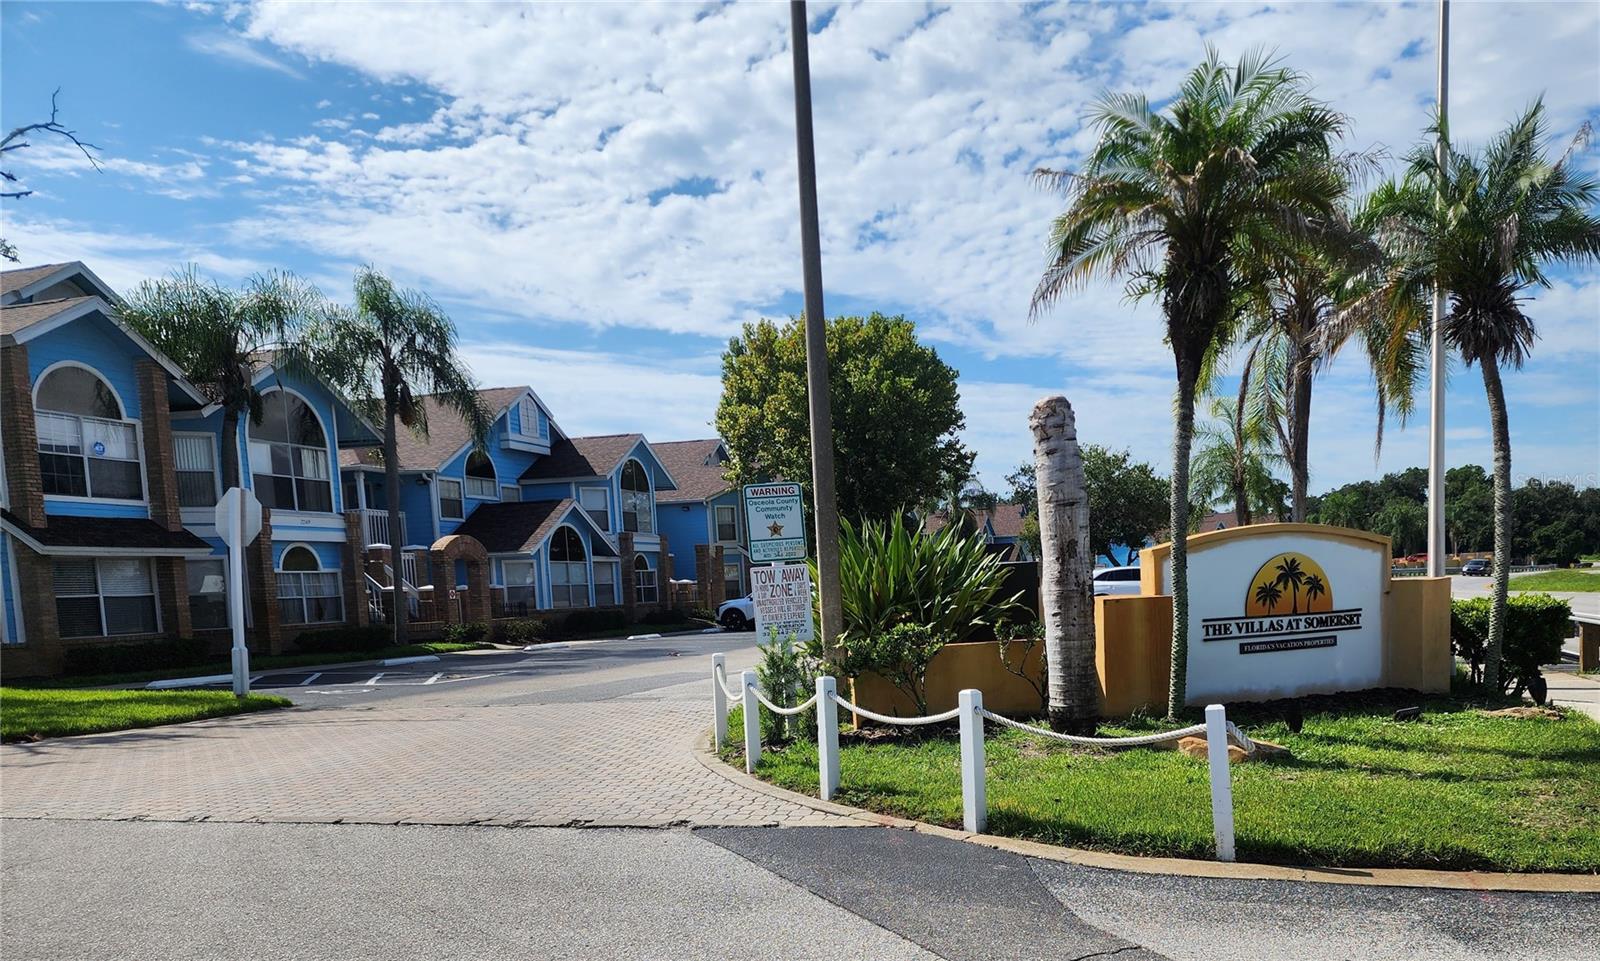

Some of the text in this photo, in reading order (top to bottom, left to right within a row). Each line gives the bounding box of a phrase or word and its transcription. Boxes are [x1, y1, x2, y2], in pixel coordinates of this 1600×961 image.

[751, 487, 795, 496] WARNING
[753, 568, 805, 584] TOW AWAY
[769, 583, 793, 597] ZONE
[1202, 613, 1362, 637] THE VILLAS AT SOMERSET
[1244, 638, 1335, 652] FLORIDA'S VACATION PROPERTIES
